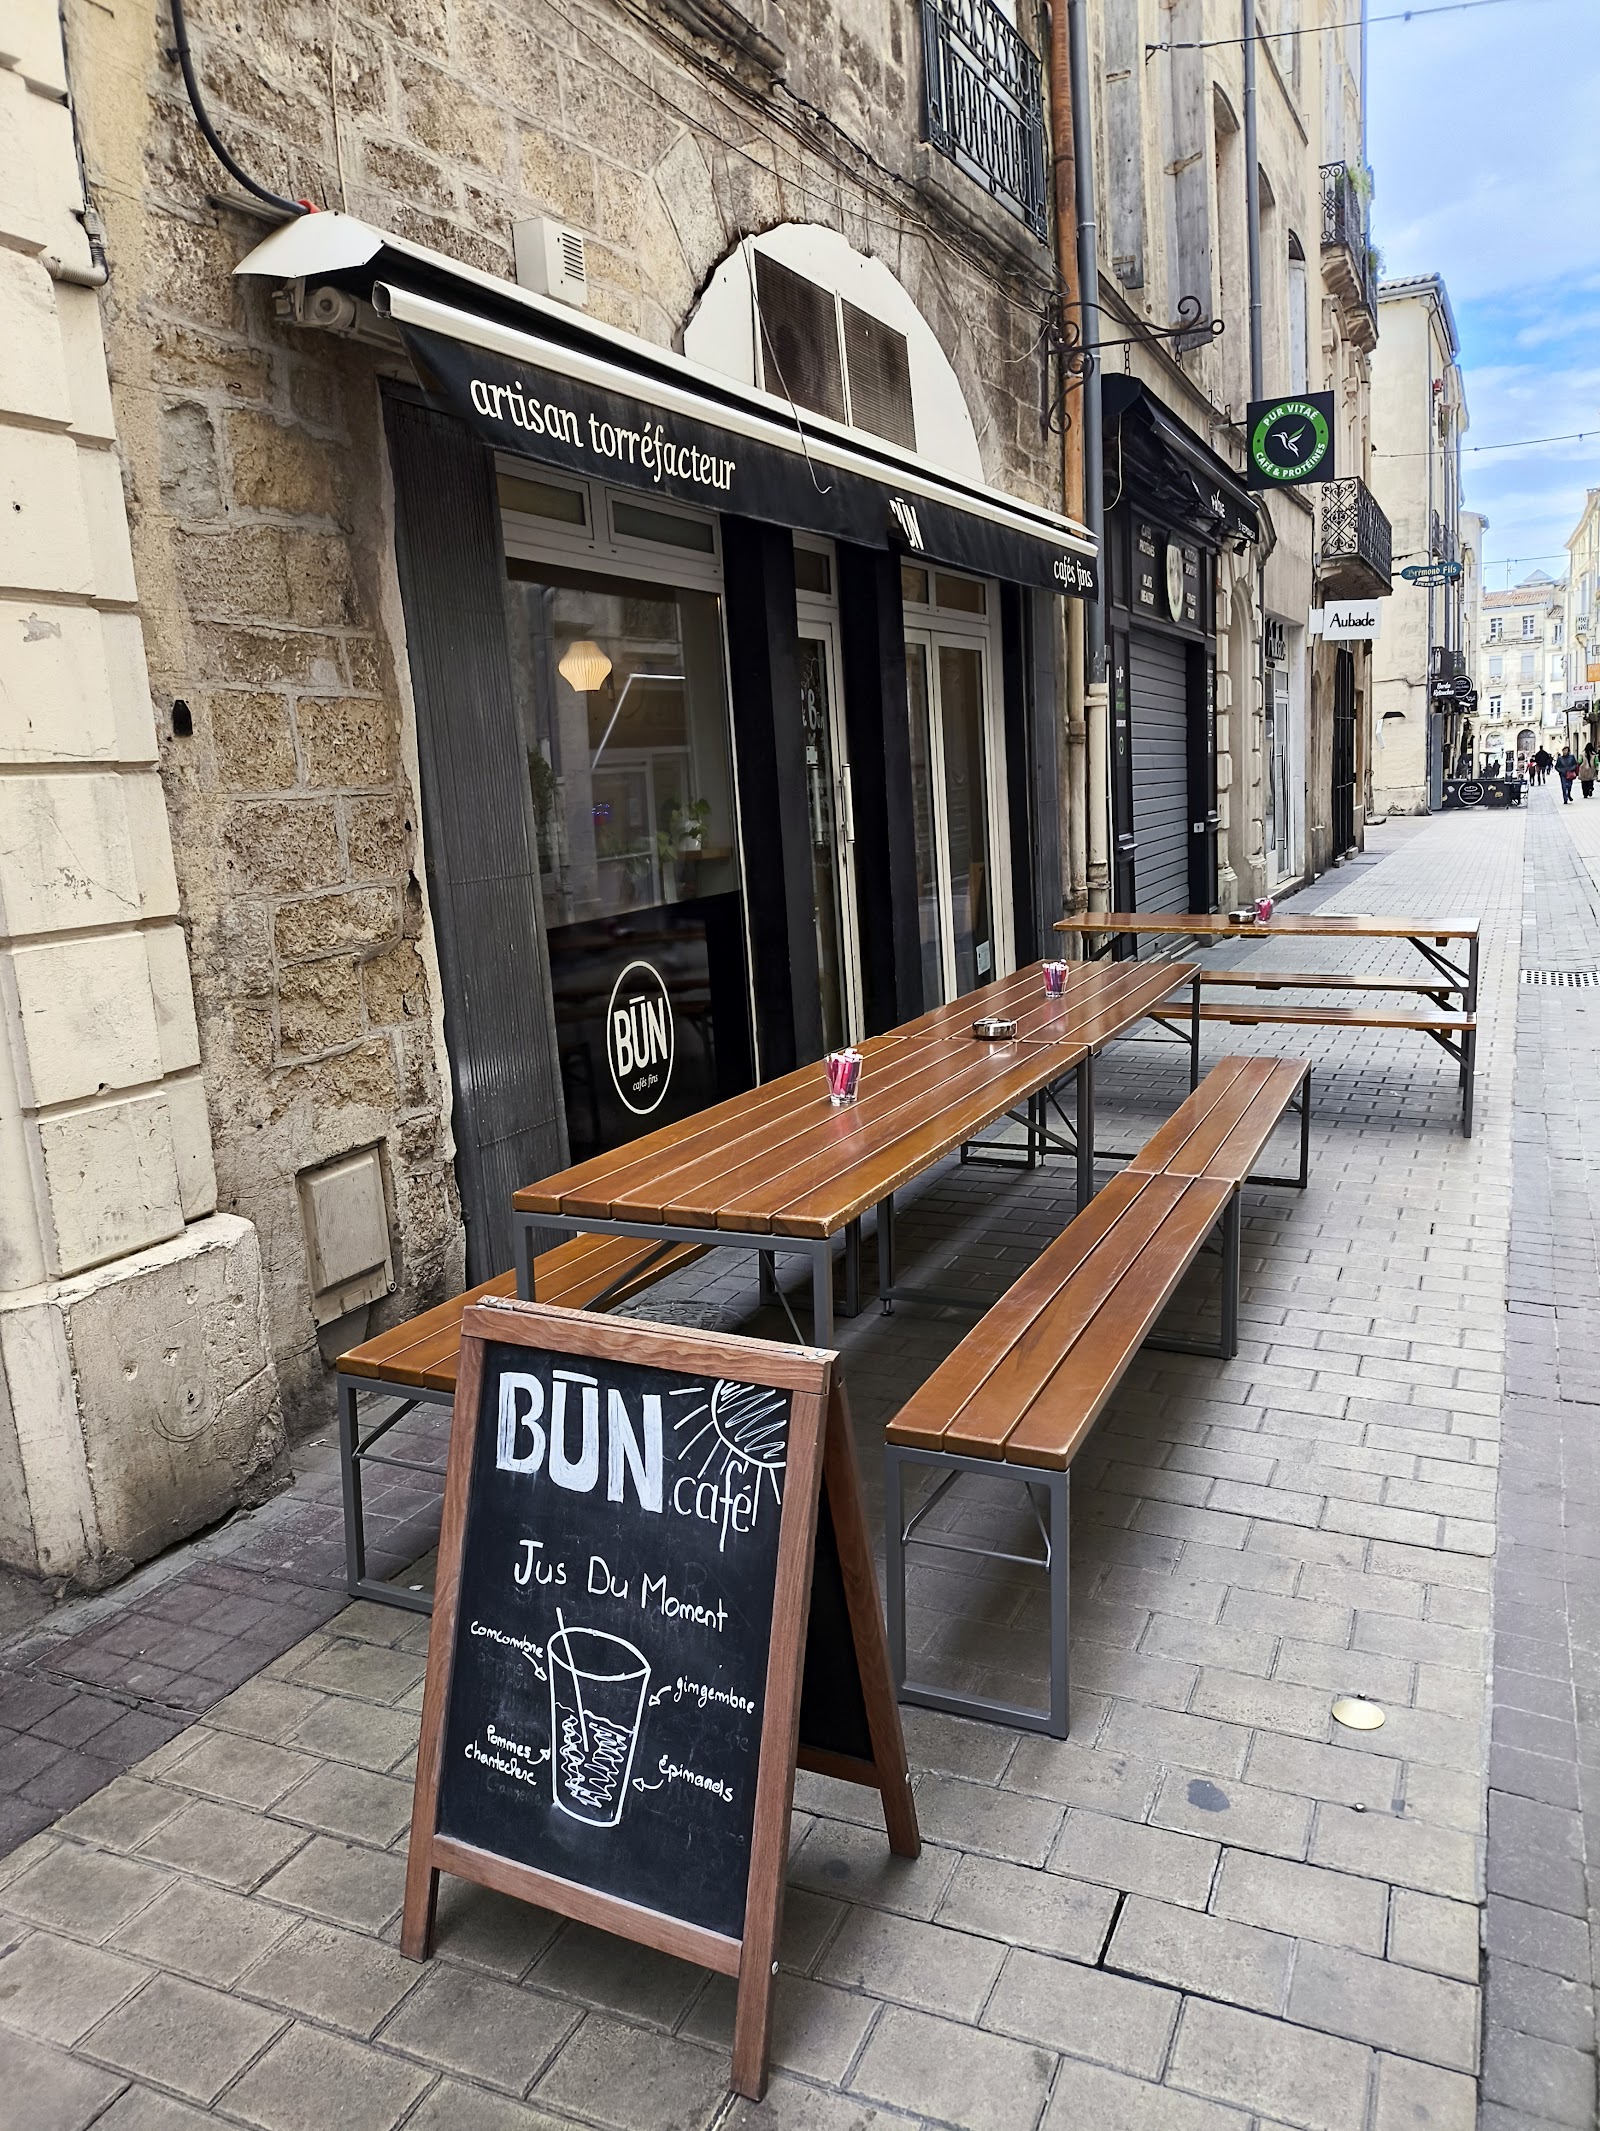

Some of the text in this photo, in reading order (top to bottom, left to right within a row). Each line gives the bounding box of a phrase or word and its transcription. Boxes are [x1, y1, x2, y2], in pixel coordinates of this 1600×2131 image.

[470, 378, 736, 491] artisan torréfacteur
[1262, 408, 1285, 427] PUR
[1256, 442, 1326, 478] CAFÉ & PROTÉINES
[1053, 555, 1094, 592] cafés fins
[1329, 611, 1376, 629] Aubade
[613, 995, 668, 1077] BŪN
[647, 1073, 659, 1089] fins
[495, 1369, 664, 1514] BŪN
[513, 1539, 729, 1633] Jus Du Moment
